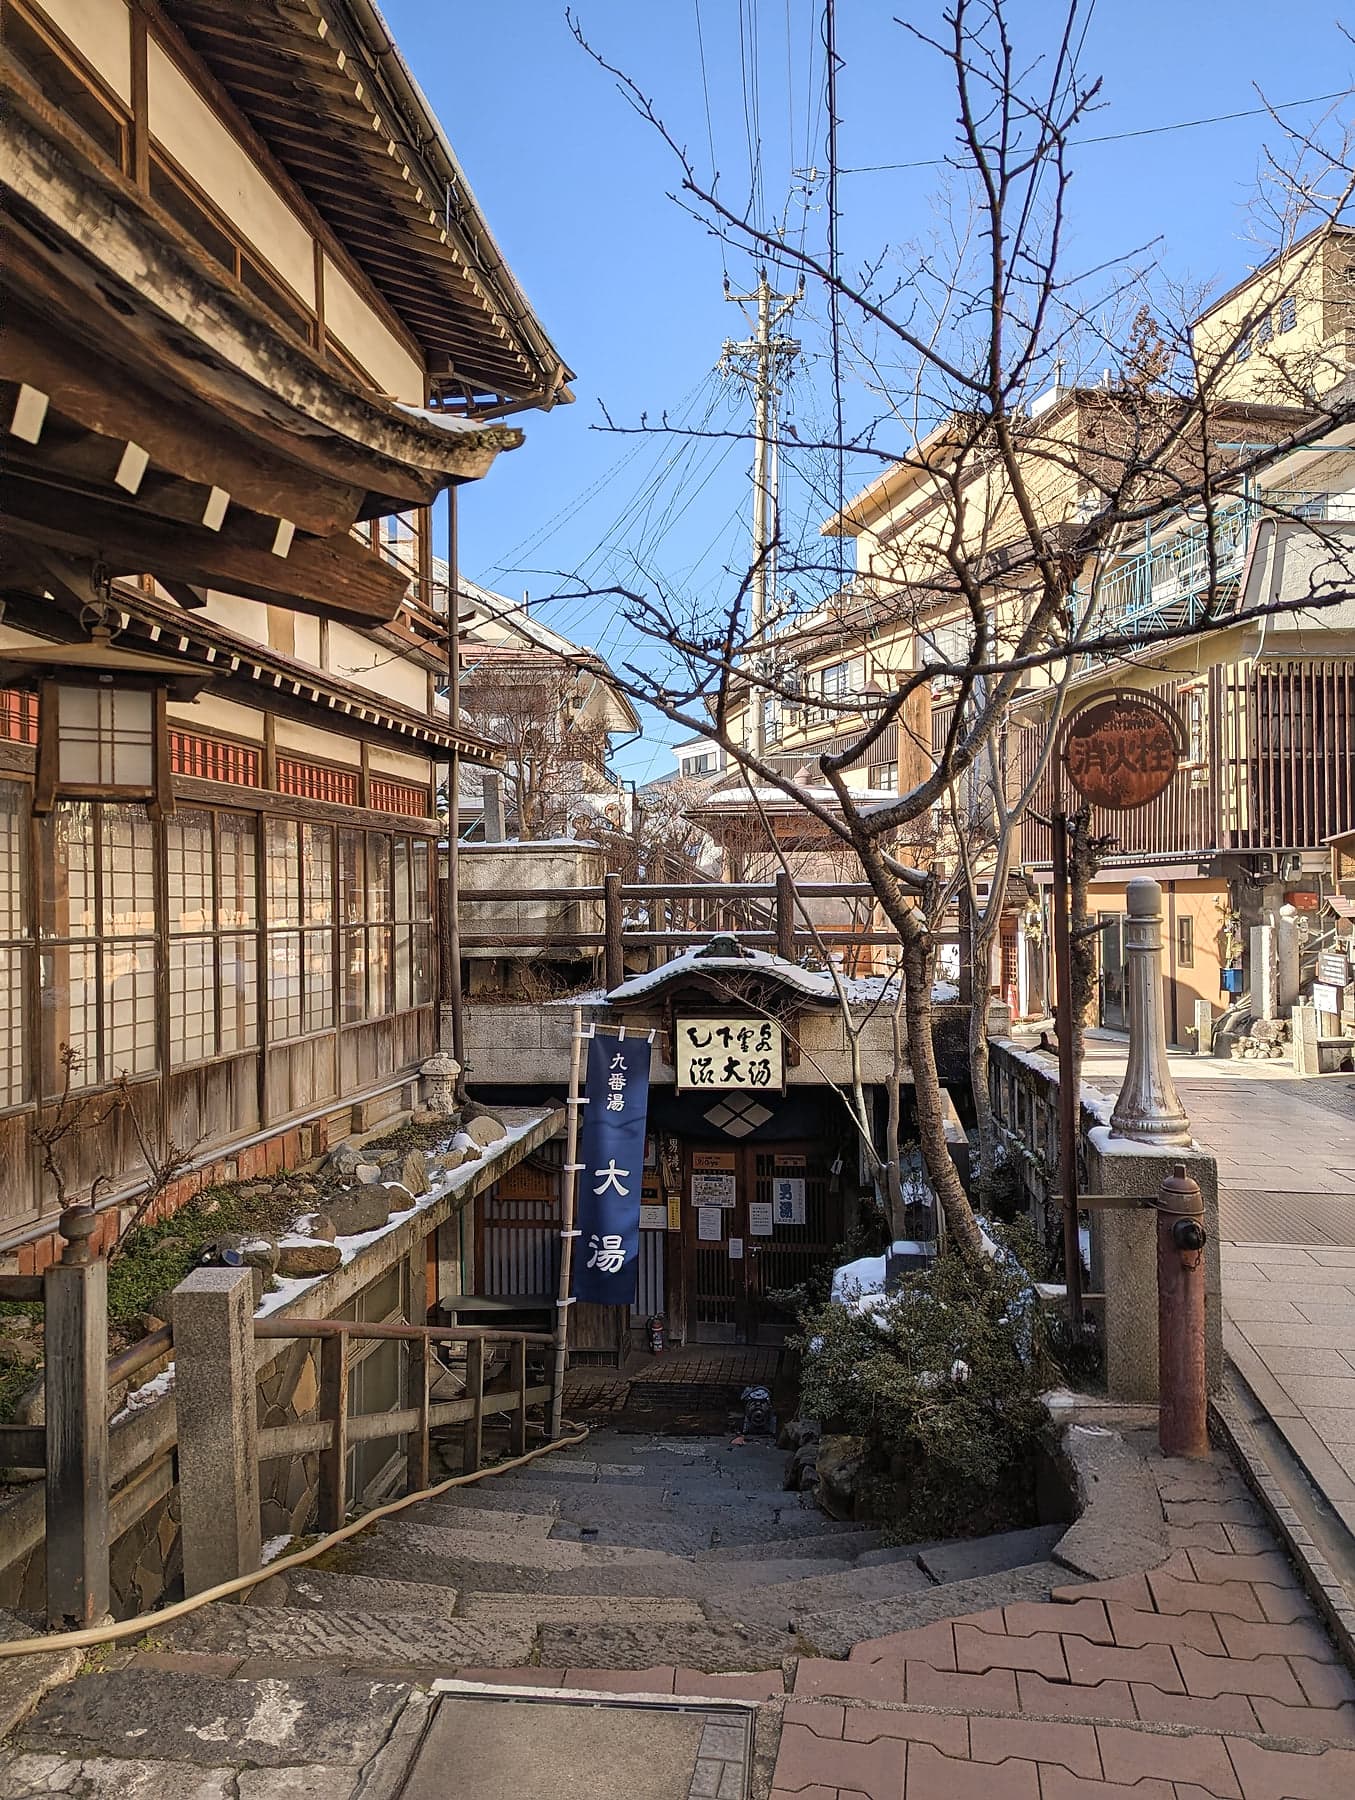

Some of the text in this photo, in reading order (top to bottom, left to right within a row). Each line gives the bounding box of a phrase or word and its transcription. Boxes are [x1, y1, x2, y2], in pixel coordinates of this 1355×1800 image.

[1072, 734, 1170, 775] 消火栓
[606, 1053, 628, 1112] 九番湯
[587, 1158, 631, 1274] 大湯
